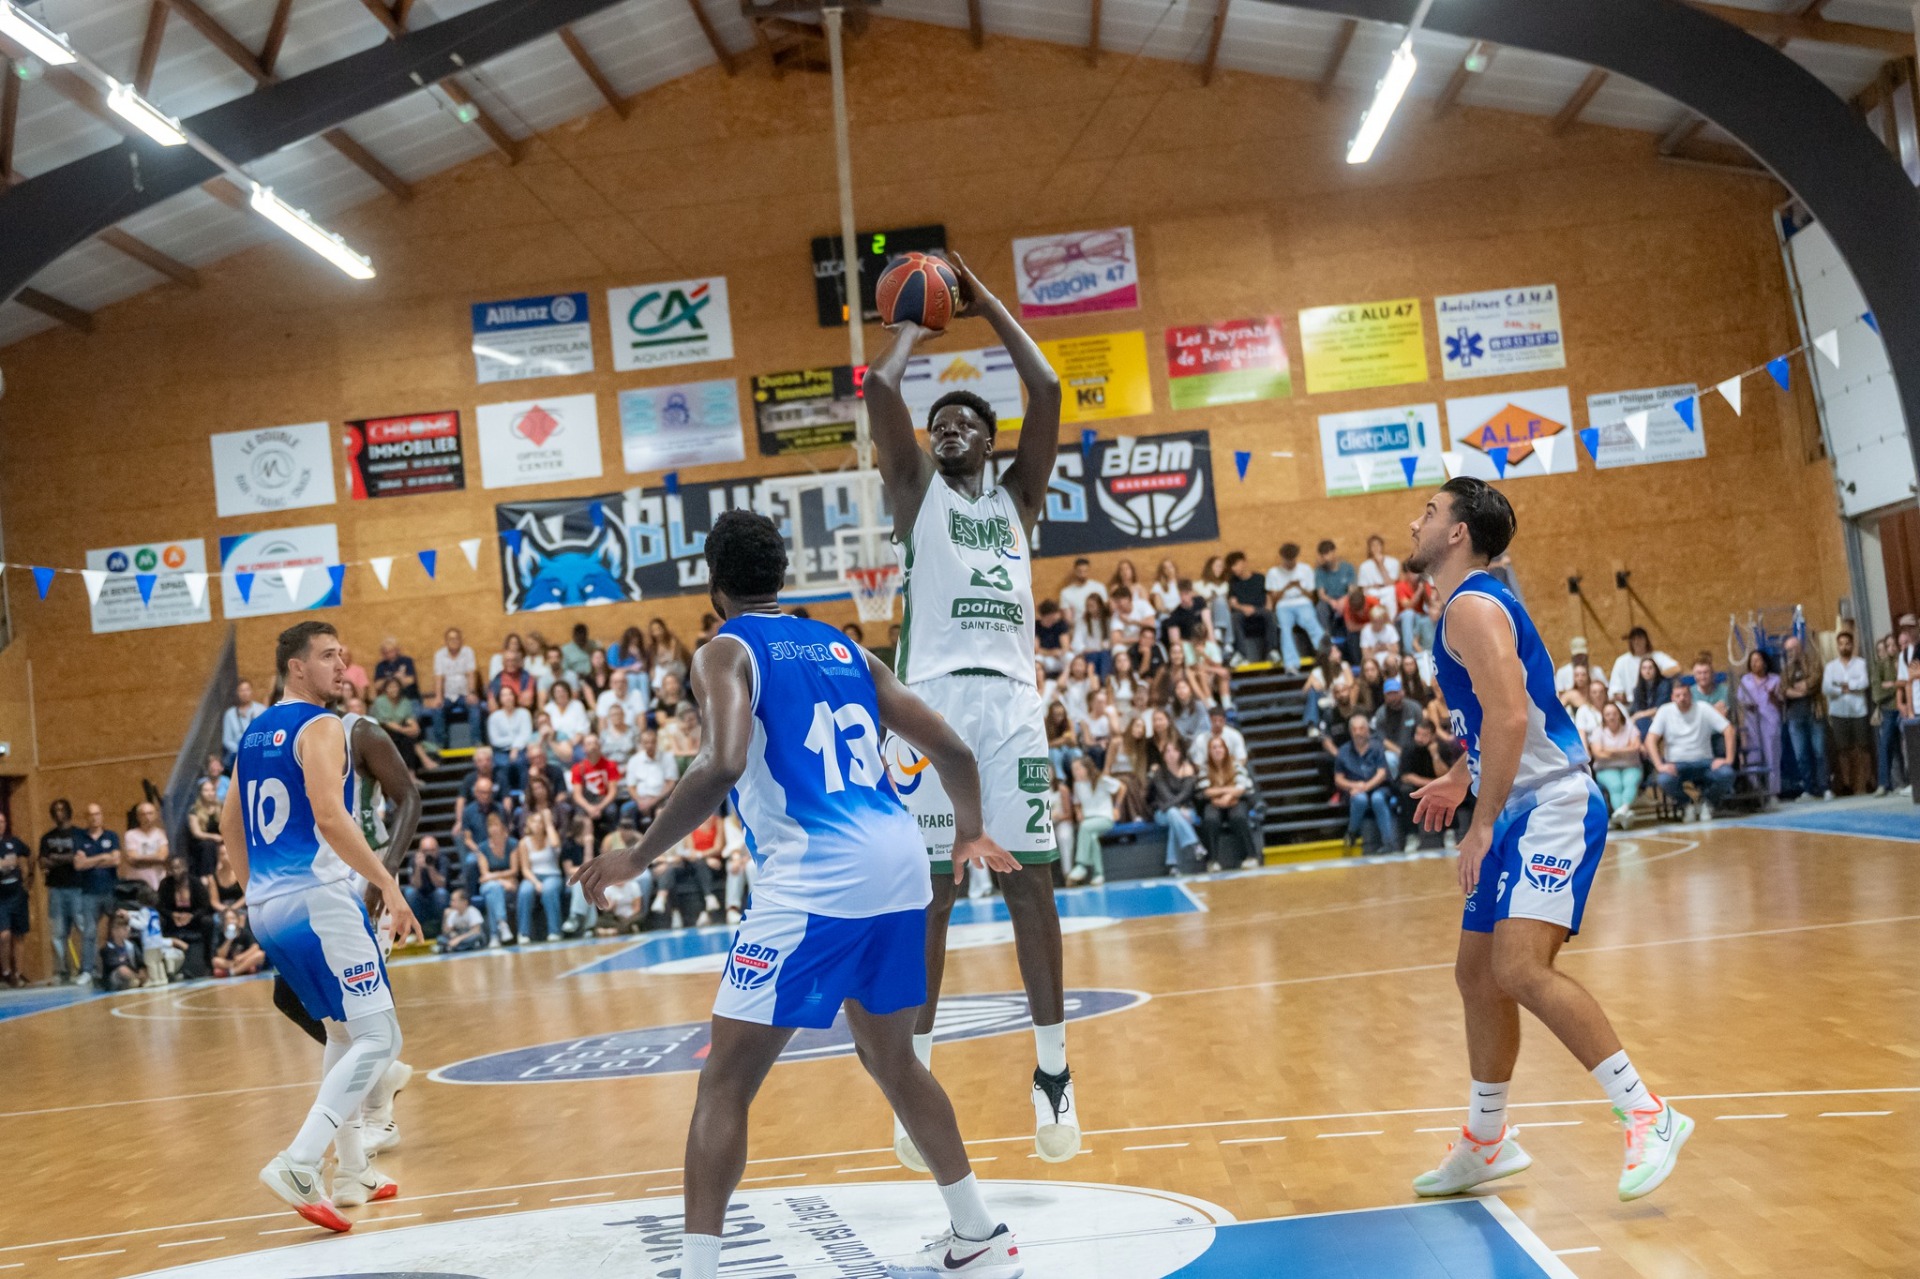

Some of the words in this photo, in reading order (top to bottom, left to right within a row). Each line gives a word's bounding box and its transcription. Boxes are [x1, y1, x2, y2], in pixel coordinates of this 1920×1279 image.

[872, 233, 886, 254] 2
[1033, 273, 1098, 303] VISION
[1106, 264, 1125, 282] 47
[486, 305, 549, 325] Allianz
[1361, 306, 1390, 321] ALU
[1394, 303, 1413, 317] 47
[1177, 332, 1202, 347] Les
[633, 348, 709, 364] AQUITAINE
[1177, 350, 1196, 366] de
[368, 436, 457, 460] IMMOBILIER
[1340, 427, 1408, 451] dietplus
[516, 450, 562, 461] OPTICAL
[1102, 440, 1193, 477] BBM
[518, 460, 562, 472] CENTER
[769, 641, 833, 662] SUPER
[834, 647, 848, 660] U
[275, 733, 284, 743] U
[803, 700, 885, 794] 13
[247, 777, 290, 846] 10
[1531, 853, 1572, 870] BBM
[735, 942, 779, 962] BBM
[343, 961, 375, 978] BBM
